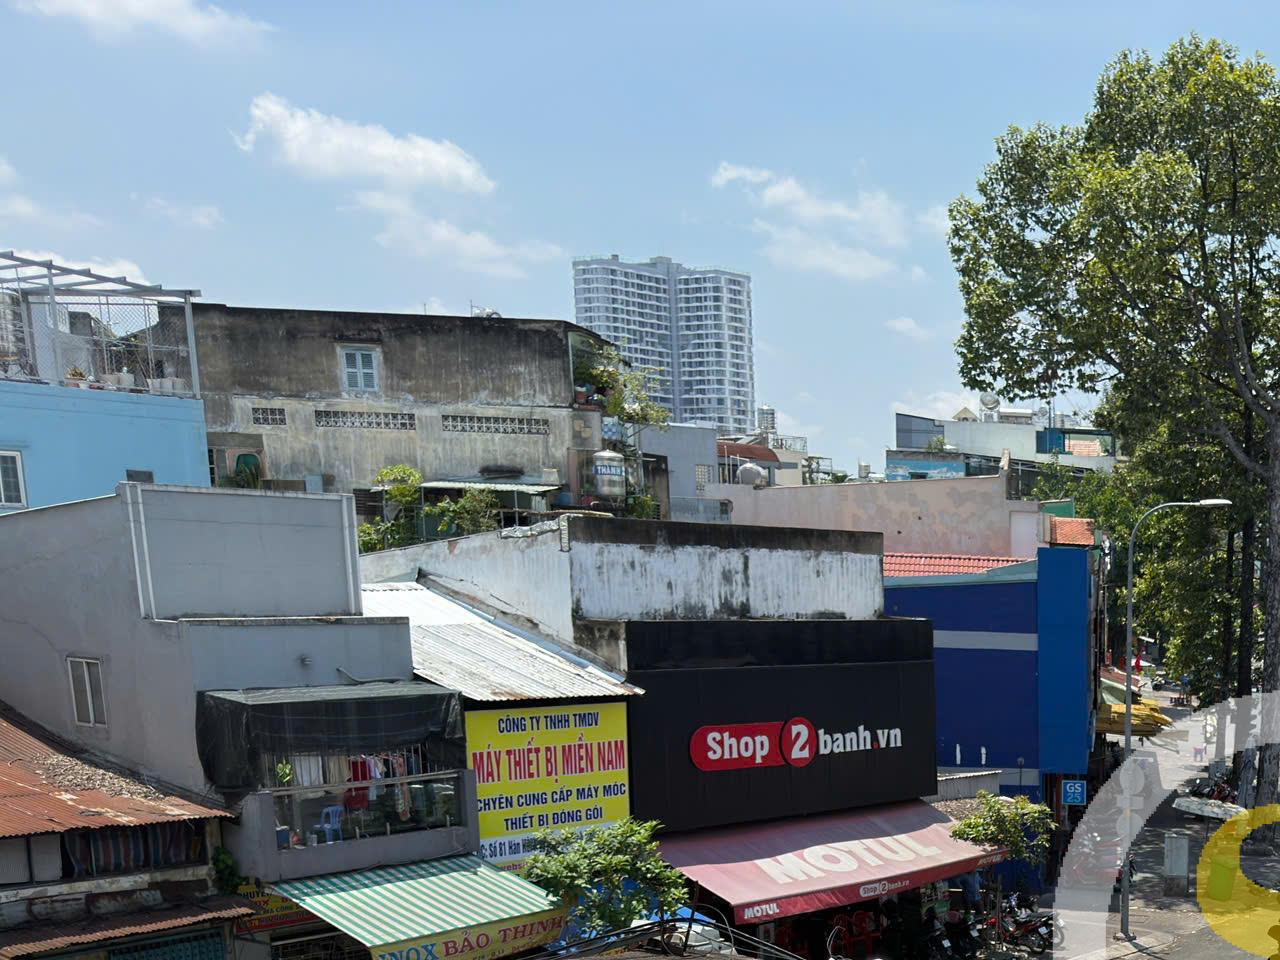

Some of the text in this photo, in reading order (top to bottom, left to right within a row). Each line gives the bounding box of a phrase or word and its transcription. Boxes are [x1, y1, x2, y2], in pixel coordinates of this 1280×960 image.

[498, 711, 599, 734] CÔNG TY TNHH TMDV
[706, 724, 902, 764] Shop 2 banh.vn
[472, 733, 626, 785] MÁY THIẾT BỊ MIỀN NAM
[477, 781, 627, 813] CHYÊN CUNG CẤP MÁY MÓC
[1066, 783, 1082, 793] GS
[1066, 793, 1082, 803] 25
[504, 806, 603, 832] THIẾT BỊ ĐÓNG GÓI
[753, 833, 943, 885] MOTUL
[862, 886, 878, 895] Shop
[744, 903, 780, 919] MOTUL
[442, 930, 490, 957] BẢO
[498, 916, 565, 944] THỊNH
